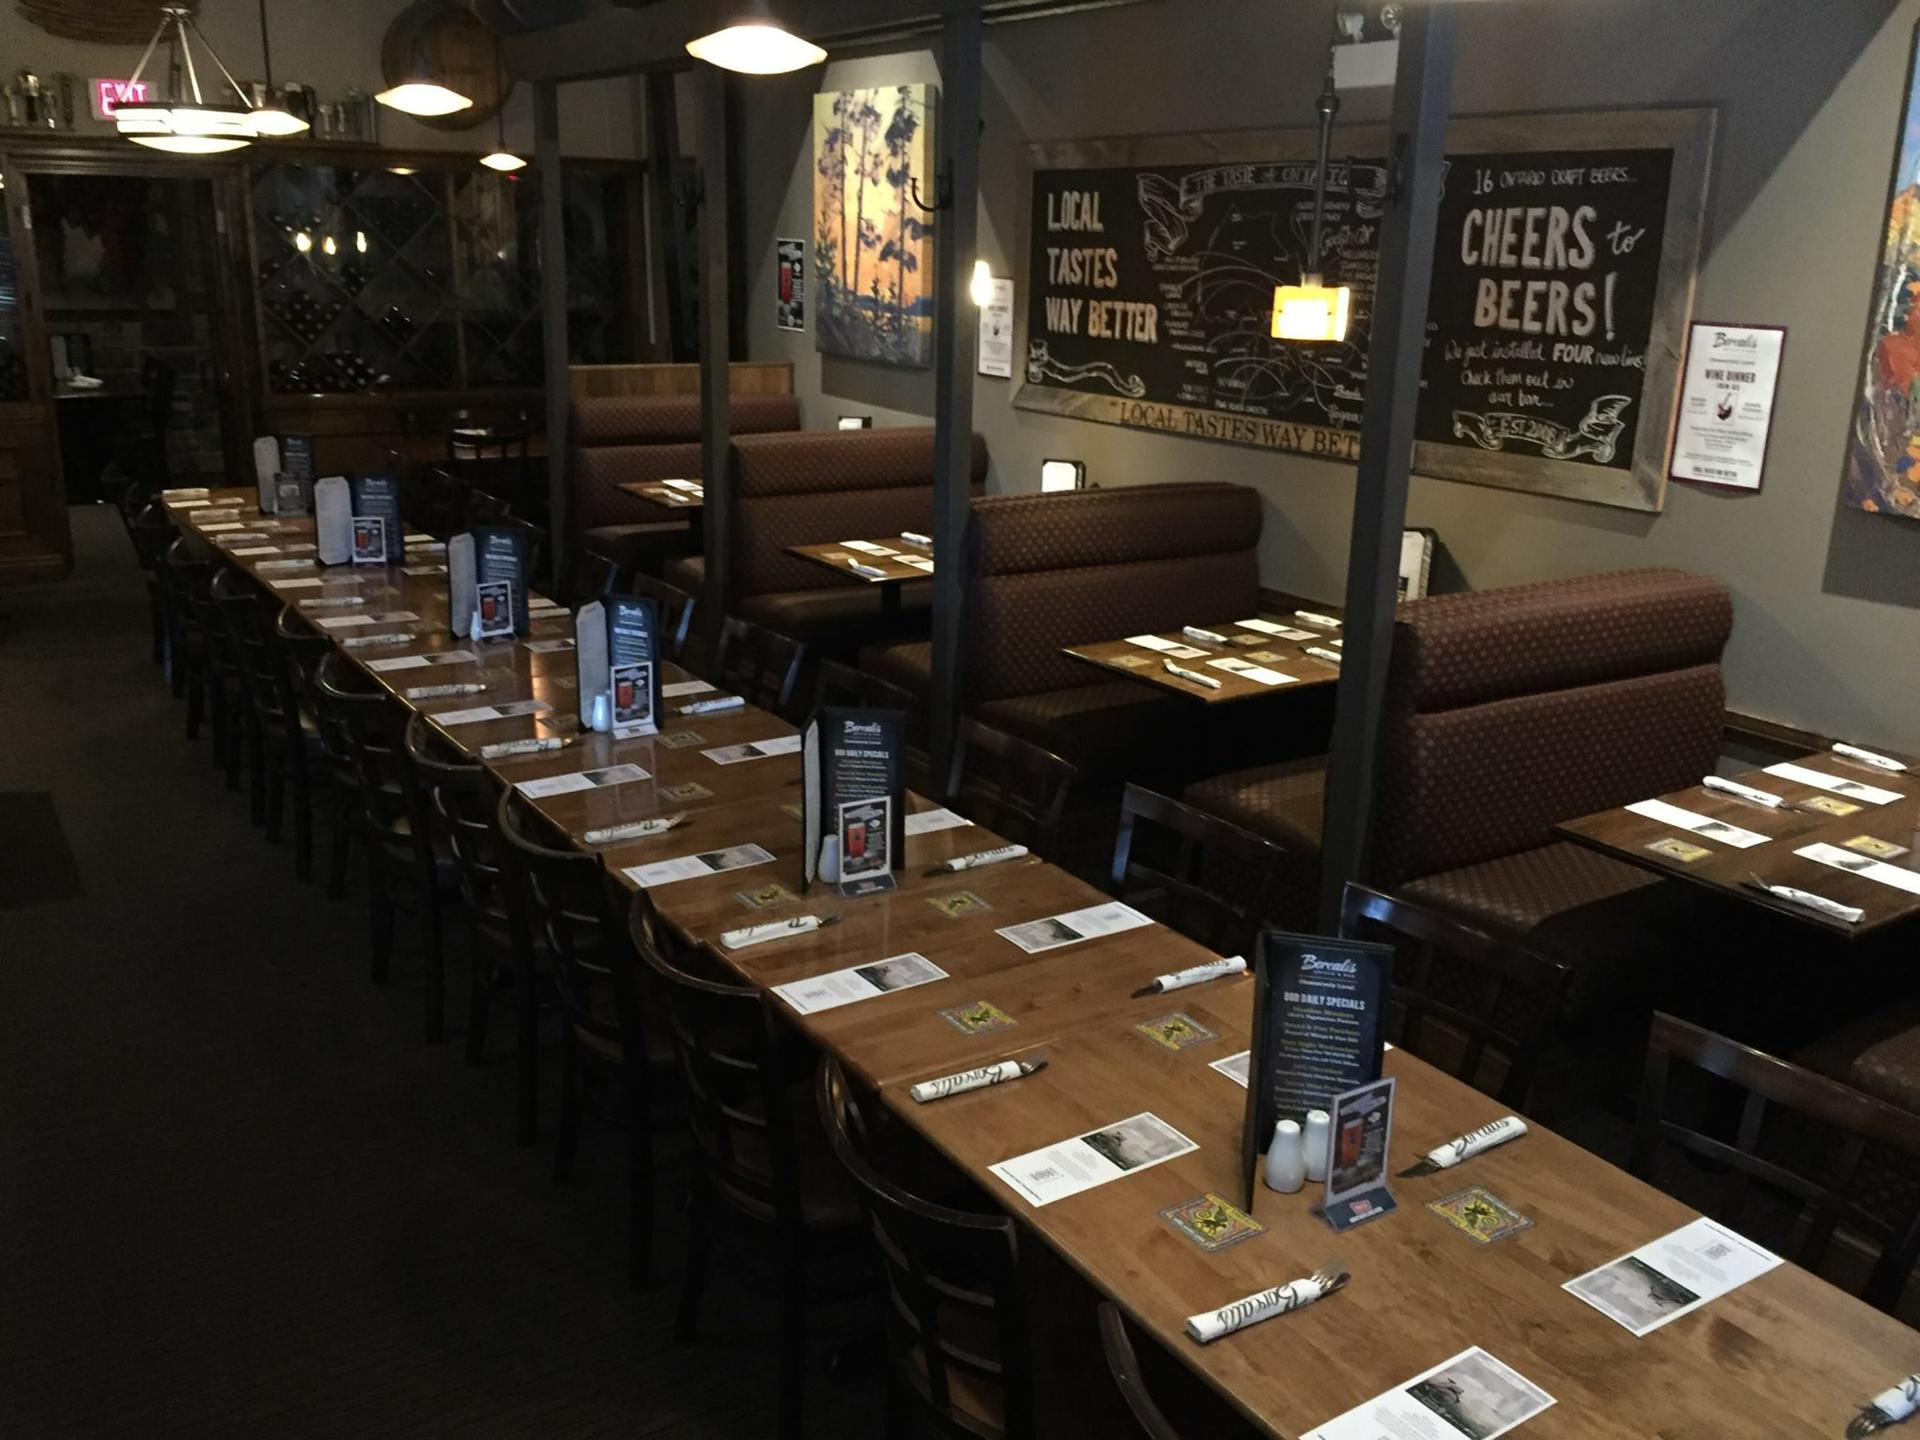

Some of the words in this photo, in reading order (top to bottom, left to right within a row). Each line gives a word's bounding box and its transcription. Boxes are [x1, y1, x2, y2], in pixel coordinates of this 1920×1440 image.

[1473, 169, 1493, 194] 16
[1551, 168, 1586, 185] CRAFT
[1047, 191, 1104, 231] LOCAL
[1461, 206, 1597, 270] CHEERS
[1607, 221, 1645, 255] to
[1047, 248, 1118, 289] TASTES
[1045, 297, 1080, 333] WAY
[1088, 303, 1158, 344] BETTER
[1552, 342, 1595, 365] FOUR
[1183, 411, 1258, 442] TASTES
[1261, 423, 1307, 449] WAY
[1301, 953, 1357, 974] Borealis
[1301, 993, 1325, 1006] DAILY
[1326, 996, 1366, 1011] SPECIALS
